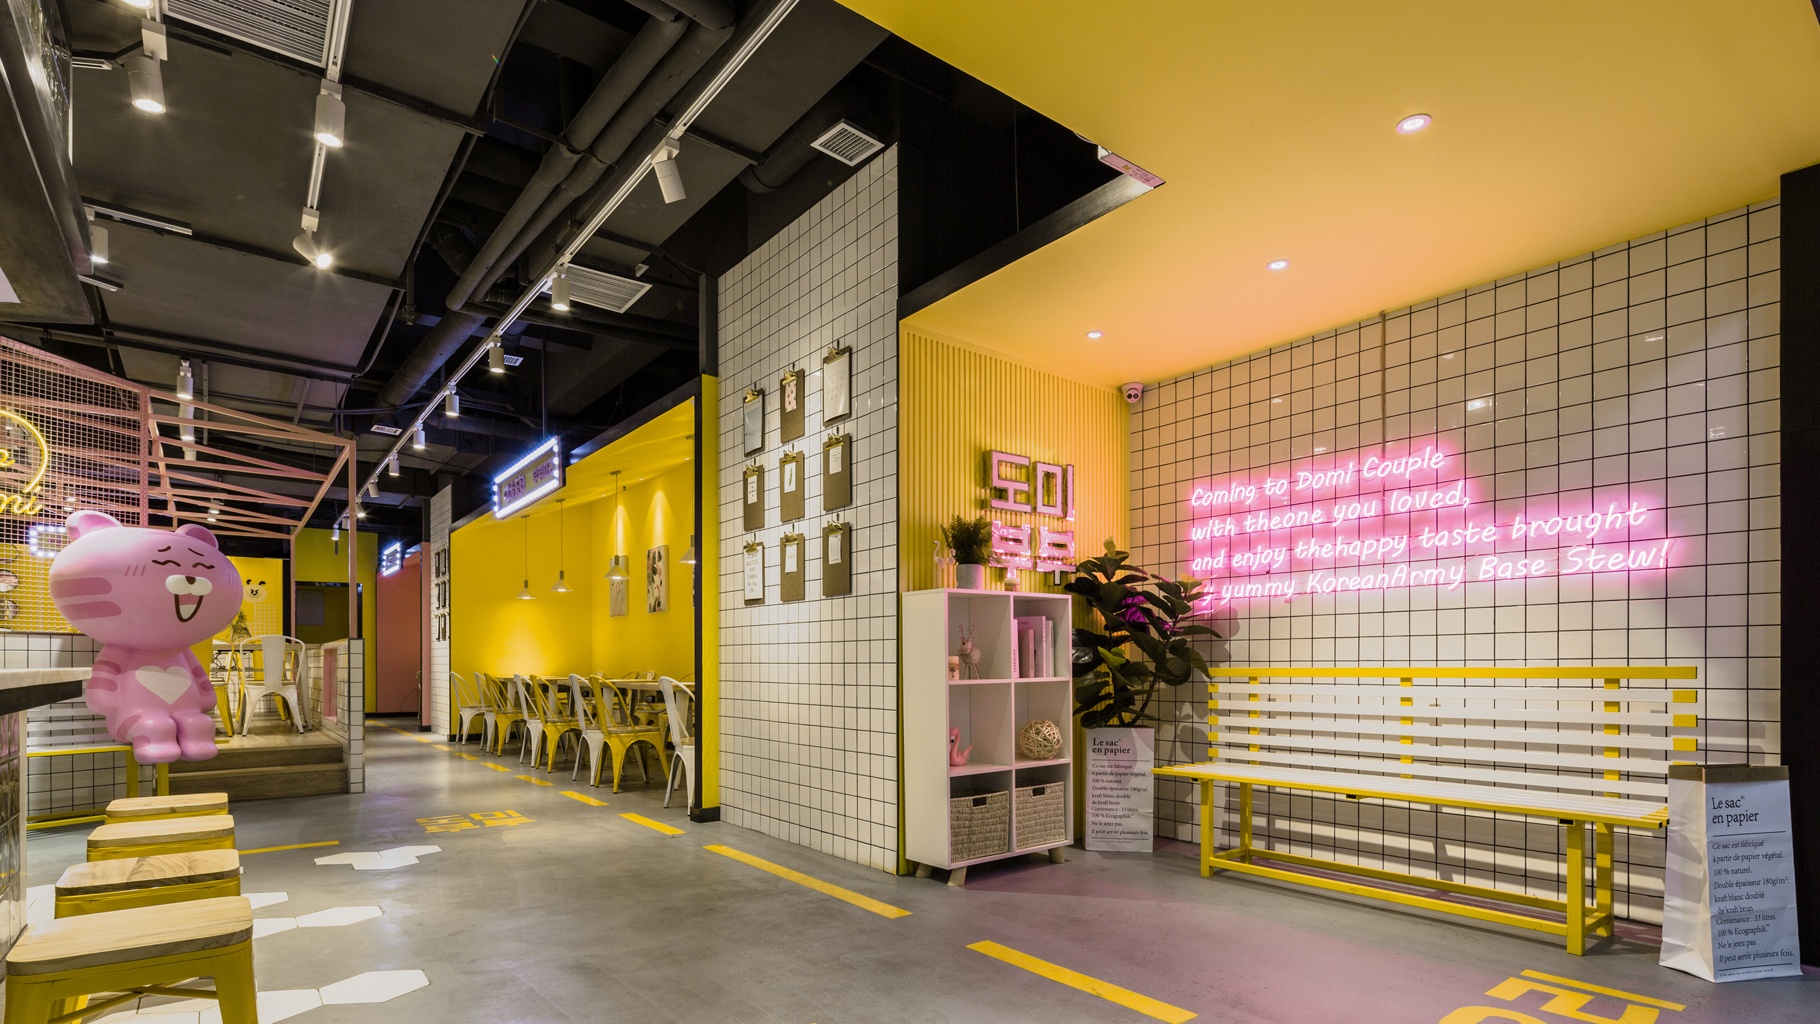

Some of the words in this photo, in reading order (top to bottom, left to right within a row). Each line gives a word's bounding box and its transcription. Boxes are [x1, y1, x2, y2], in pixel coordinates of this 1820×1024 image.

[1191, 483, 1256, 506] Coming
[1263, 478, 1288, 496] to
[1295, 462, 1353, 490] Domi
[1363, 446, 1445, 479] Couple
[990, 450, 1075, 521] 도미
[1192, 517, 1236, 541] with
[1244, 509, 1323, 533] theone
[1332, 499, 1376, 526] you
[1390, 480, 1470, 513] loved,
[1192, 549, 1225, 571] and
[1232, 545, 1286, 571] enjoy
[1295, 536, 1407, 561] thehappy
[1418, 522, 1497, 548] taste
[1511, 502, 1648, 540] brought
[989, 520, 1077, 585] 부부
[1220, 579, 1296, 605] yummy
[1478, 556, 1548, 580] Base
[1561, 538, 1671, 574] Stew!
[1092, 738, 1104, 746] Le
[1104, 747, 1131, 756] papier
[1711, 797, 1723, 810] Le
[1712, 813, 1724, 824] en
[1726, 809, 1759, 827] papier
[1712, 842, 1720, 850] Ce
[1740, 840, 1765, 849] fabriqué
[1716, 854, 1732, 864] partir
[1733, 853, 1740, 861] de
[1741, 852, 1760, 862] papier
[1713, 868, 1723, 876] 100
[1731, 866, 1752, 875] naturel.
[1713, 880, 1735, 890] Double
[1735, 879, 1761, 889] épaisseur
[1714, 893, 1728, 903] kraft
[1728, 893, 1744, 902] blanc
[1717, 906, 1725, 915] de
[1725, 905, 1738, 914] kraft
[1738, 904, 1754, 913] brun
[1762, 913, 1776, 921] litres.
[1718, 929, 1727, 937] 100
[1717, 941, 1726, 949] Ne
[1727, 940, 1732, 948] le
[1746, 940, 1757, 948] pas.
[1724, 954, 1737, 964] peut
[1737, 952, 1752, 961] servir
[1752, 950, 1779, 961] plusieurs
[1780, 949, 1795, 957] fois.
